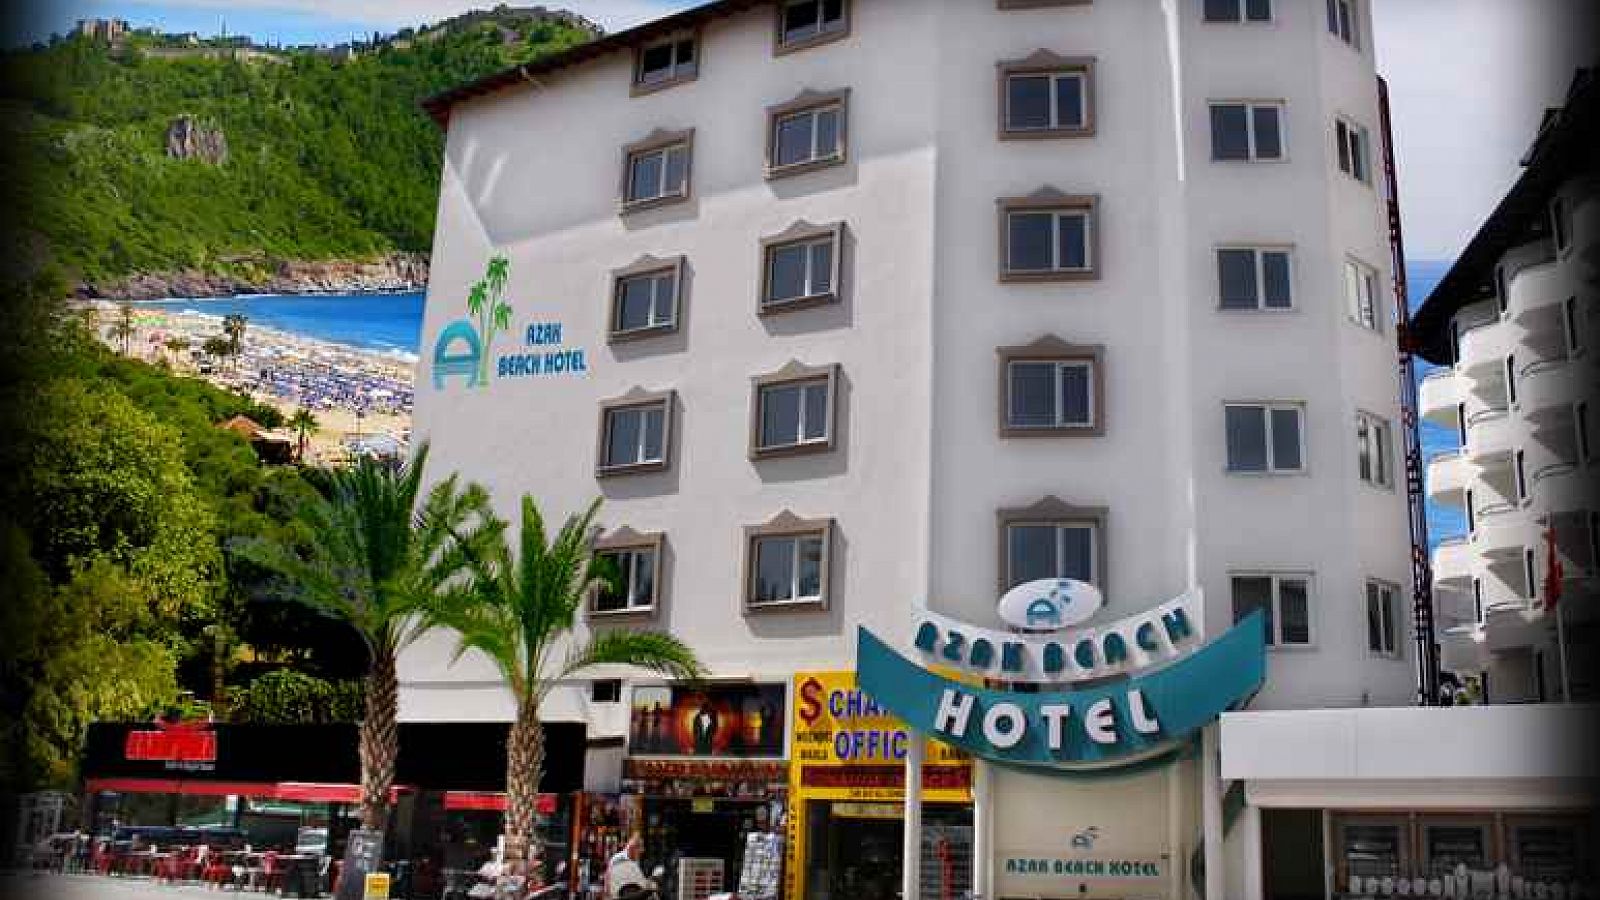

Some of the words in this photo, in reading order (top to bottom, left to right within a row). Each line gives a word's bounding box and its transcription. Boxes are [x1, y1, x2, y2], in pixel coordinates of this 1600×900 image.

[528, 323, 562, 345] AZAK
[498, 353, 542, 377] BEACH
[544, 349, 587, 374] HOTEL
[914, 620, 1025, 674] AZAK
[1042, 606, 1192, 675] BEACH
[933, 688, 1160, 749] HOTEL
[1055, 859, 1104, 875] BEACH
[1109, 859, 1160, 877] HOTEL
